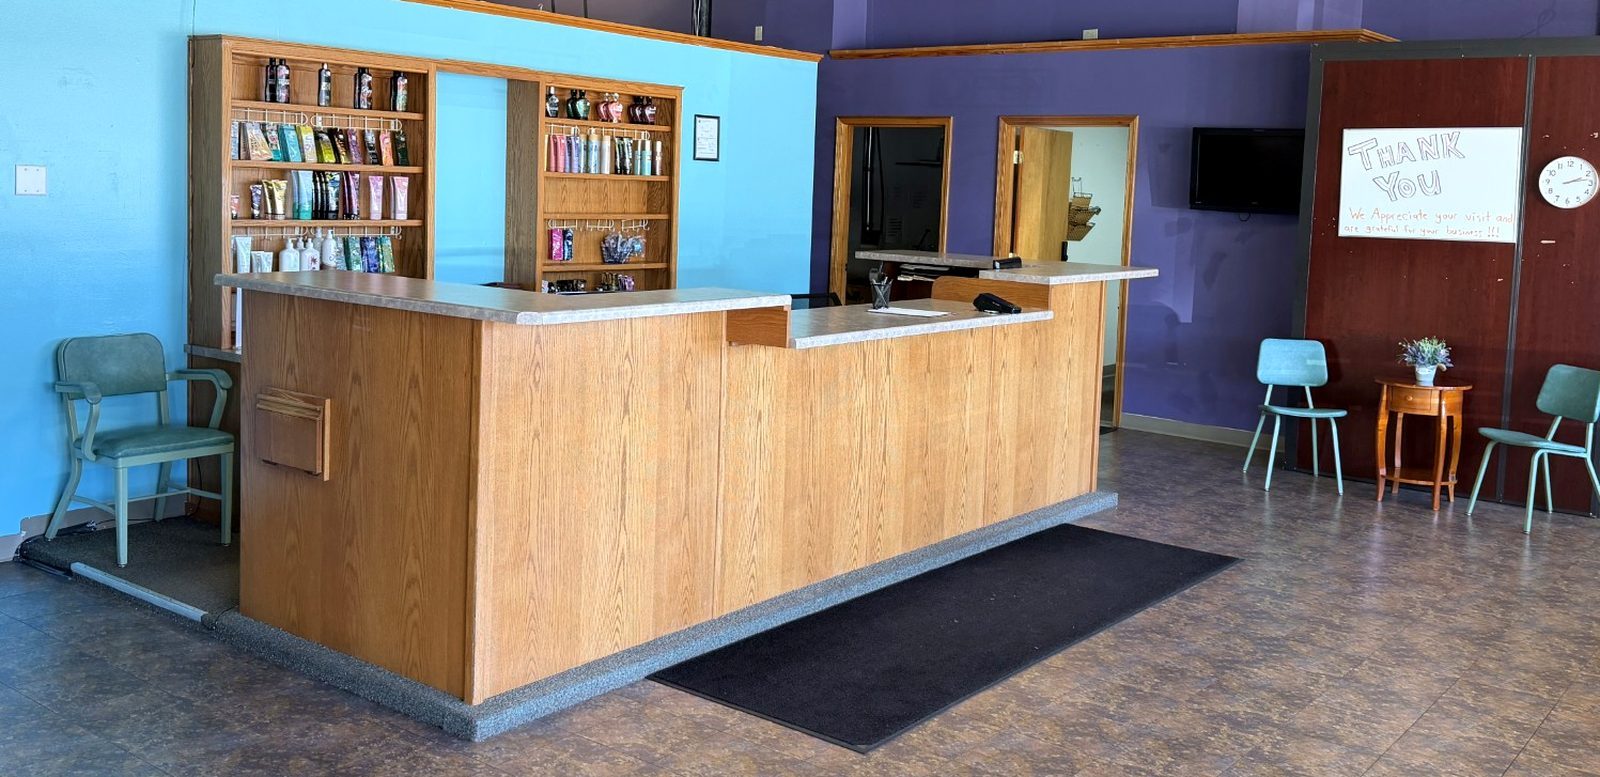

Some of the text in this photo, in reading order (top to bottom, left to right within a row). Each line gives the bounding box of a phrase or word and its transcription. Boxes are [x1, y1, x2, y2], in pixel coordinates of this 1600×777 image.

[1347, 131, 1466, 171] THANK
[1372, 170, 1442, 202] YOU
[1348, 207, 1514, 224] We Appreciate your visit and
[1343, 225, 1360, 233] are
[1364, 225, 1399, 234] grateful
[1403, 224, 1416, 234] for
[1419, 226, 1439, 237] your
[1446, 224, 1484, 238] business
